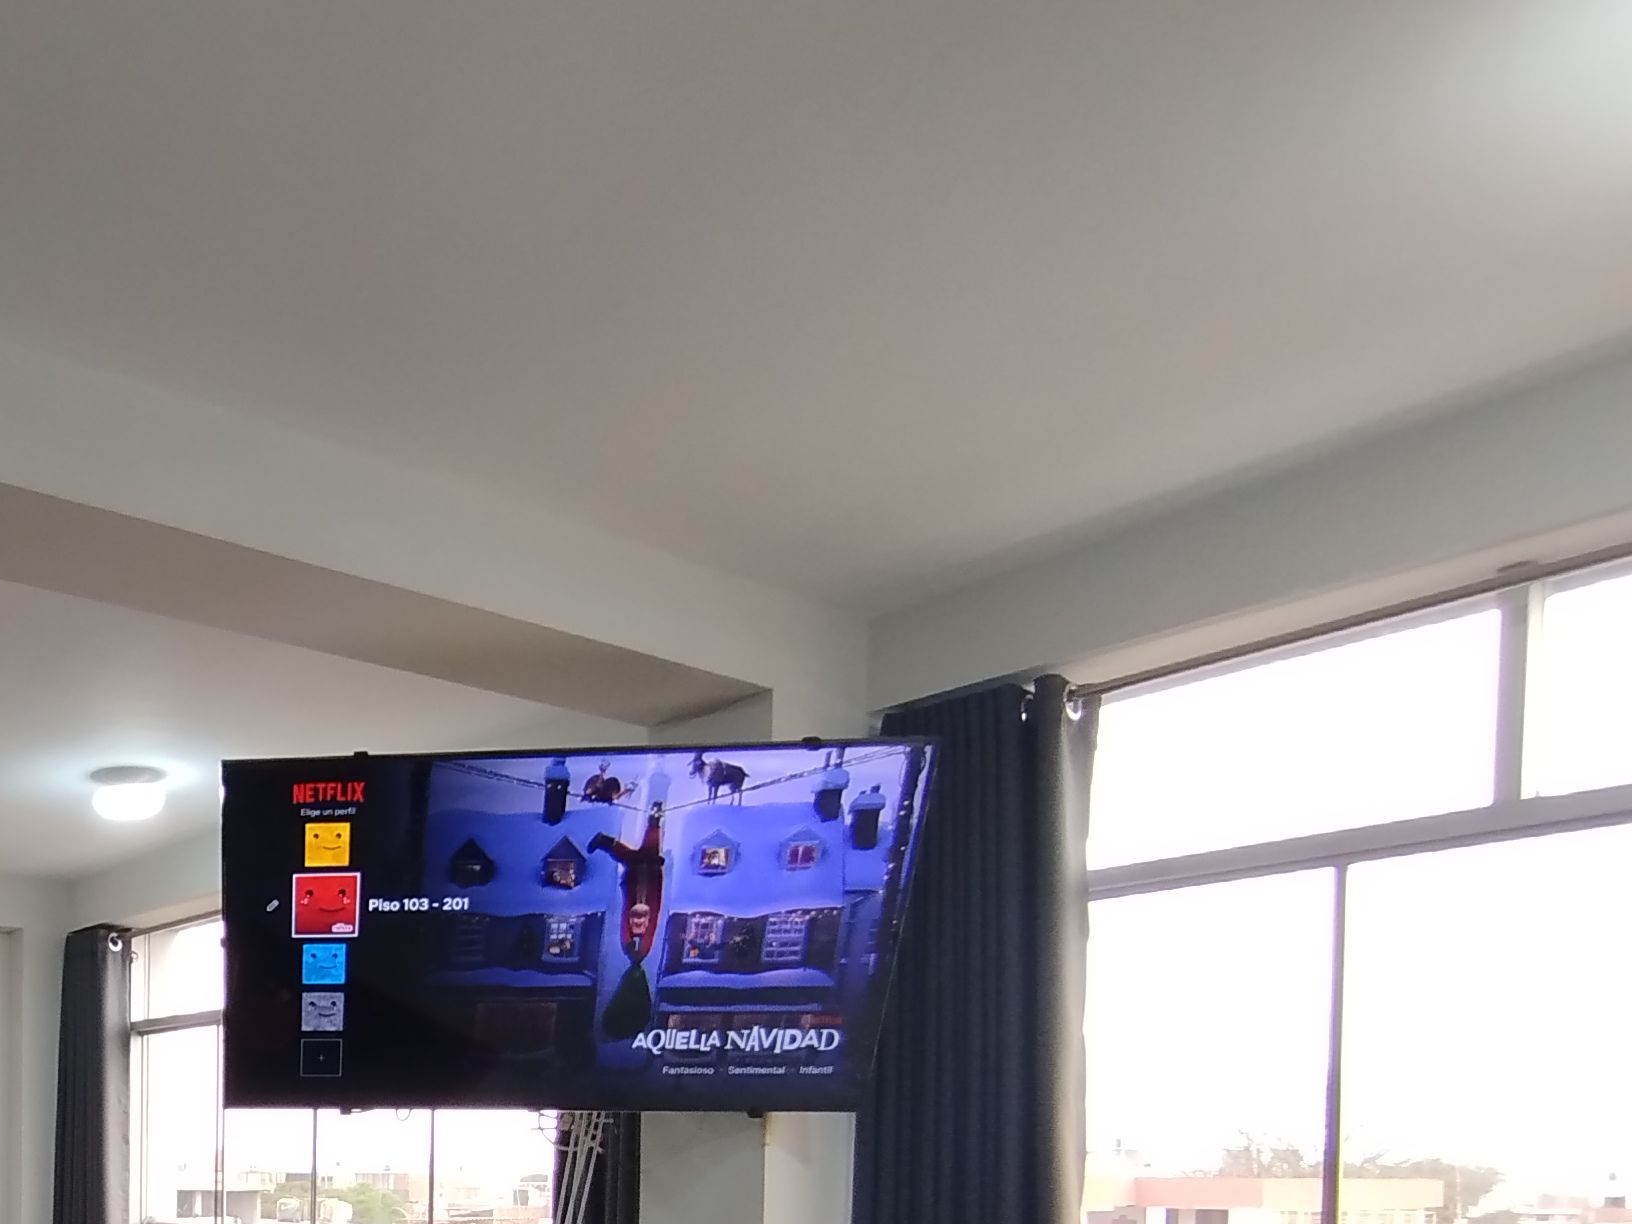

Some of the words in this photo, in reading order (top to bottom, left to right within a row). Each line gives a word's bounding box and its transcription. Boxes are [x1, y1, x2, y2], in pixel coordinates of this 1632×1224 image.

[292, 782, 366, 804] NETFLIX
[300, 808, 321, 818] Elige
[334, 807, 356, 817] perfil
[368, 899, 402, 912] Piso
[403, 898, 429, 911] 103
[442, 897, 469, 910] 201
[632, 1029, 720, 1055] AQUELLA
[724, 1026, 840, 1054] NAVIDAD
[662, 1065, 715, 1075] Fantasioso
[728, 1065, 786, 1075] Sentimental
[799, 1065, 834, 1075] Infantil
